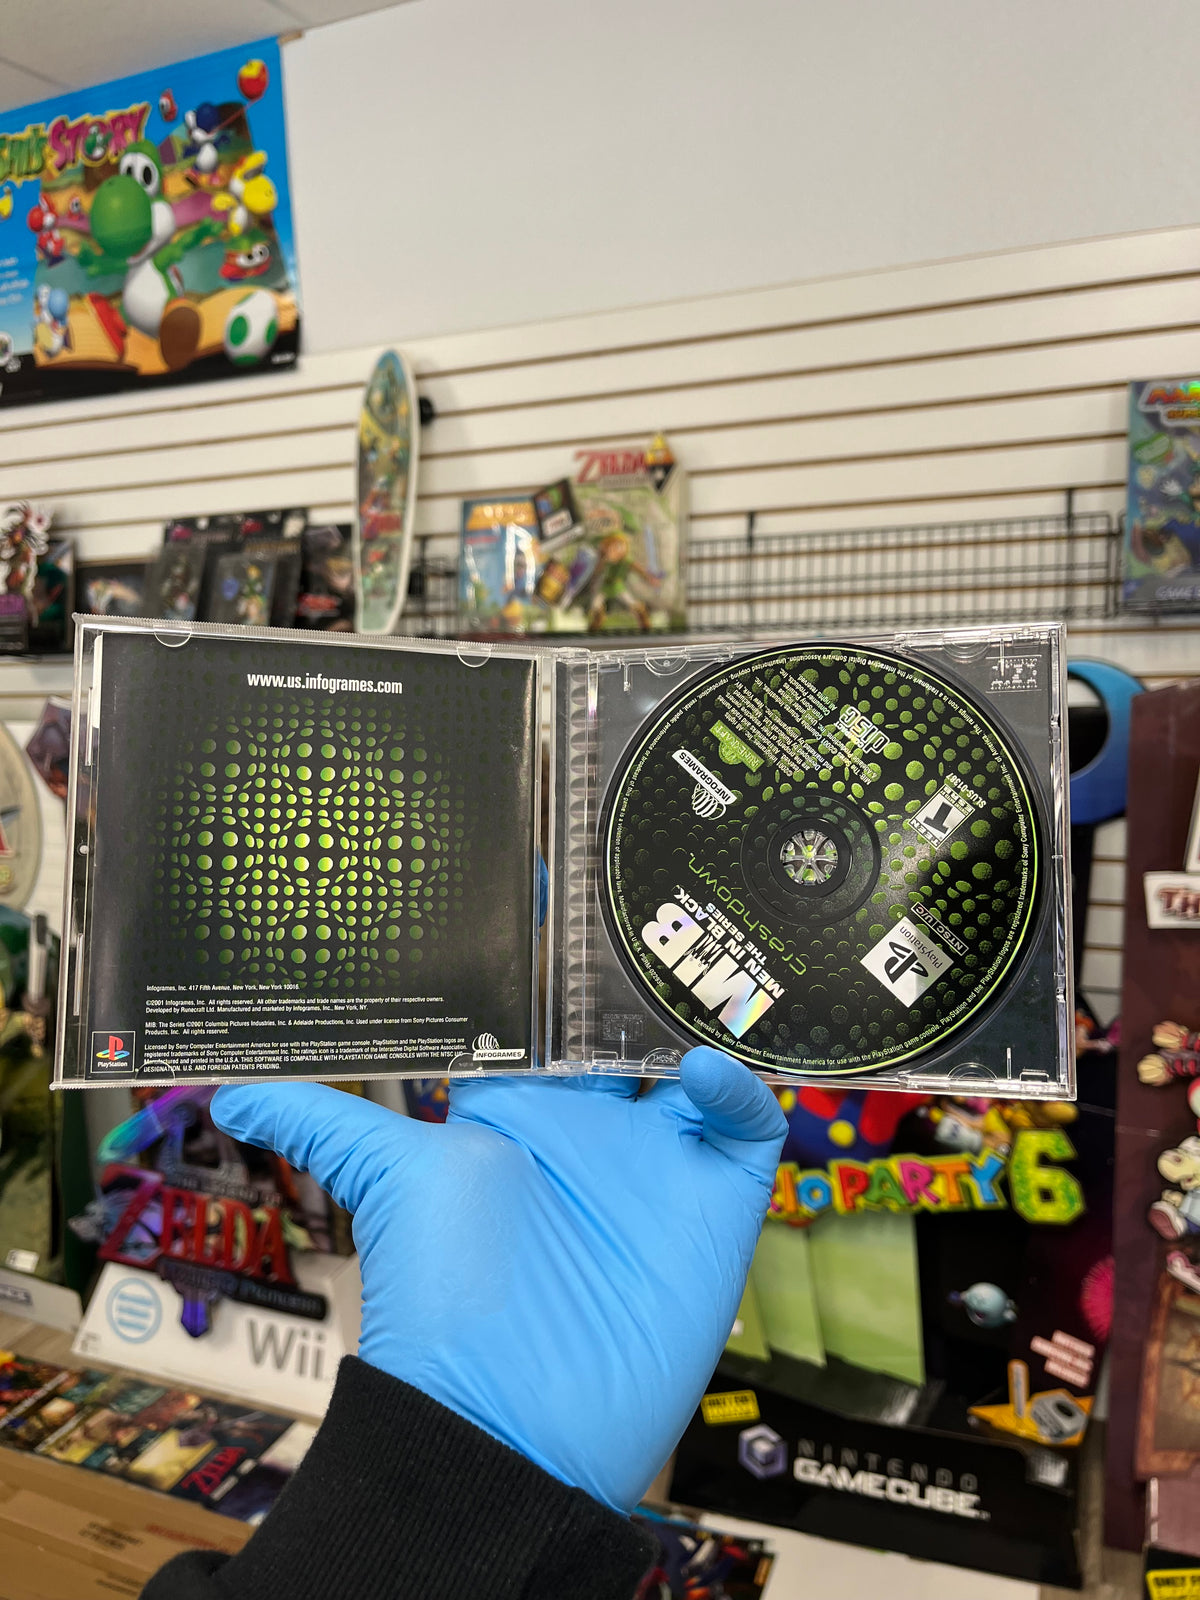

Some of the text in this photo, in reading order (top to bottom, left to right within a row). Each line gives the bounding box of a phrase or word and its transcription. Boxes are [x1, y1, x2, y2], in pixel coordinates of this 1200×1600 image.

[247, 673, 403, 694] www.us.infogrames.com
[677, 751, 731, 801] INFOGRAMES
[945, 771, 987, 808] SLUS-01387
[910, 818, 939, 846] TEEN
[673, 886, 785, 998] MEN IN BLACK
[686, 856, 807, 975] crashdown
[704, 901, 767, 965] THE SERIES
[899, 925, 942, 968] PlayStation
[915, 905, 963, 950] NTSC U/C
[641, 902, 775, 1040] MIB
[832, 1151, 1005, 1212] PARTY
[1010, 1129, 1083, 1224] 6
[97, 1163, 298, 1288] ZELDA
[249, 1319, 325, 1381] Wii
[793, 1456, 981, 1519] GAMECUBE
[798, 1438, 979, 1493] NINTENDO
